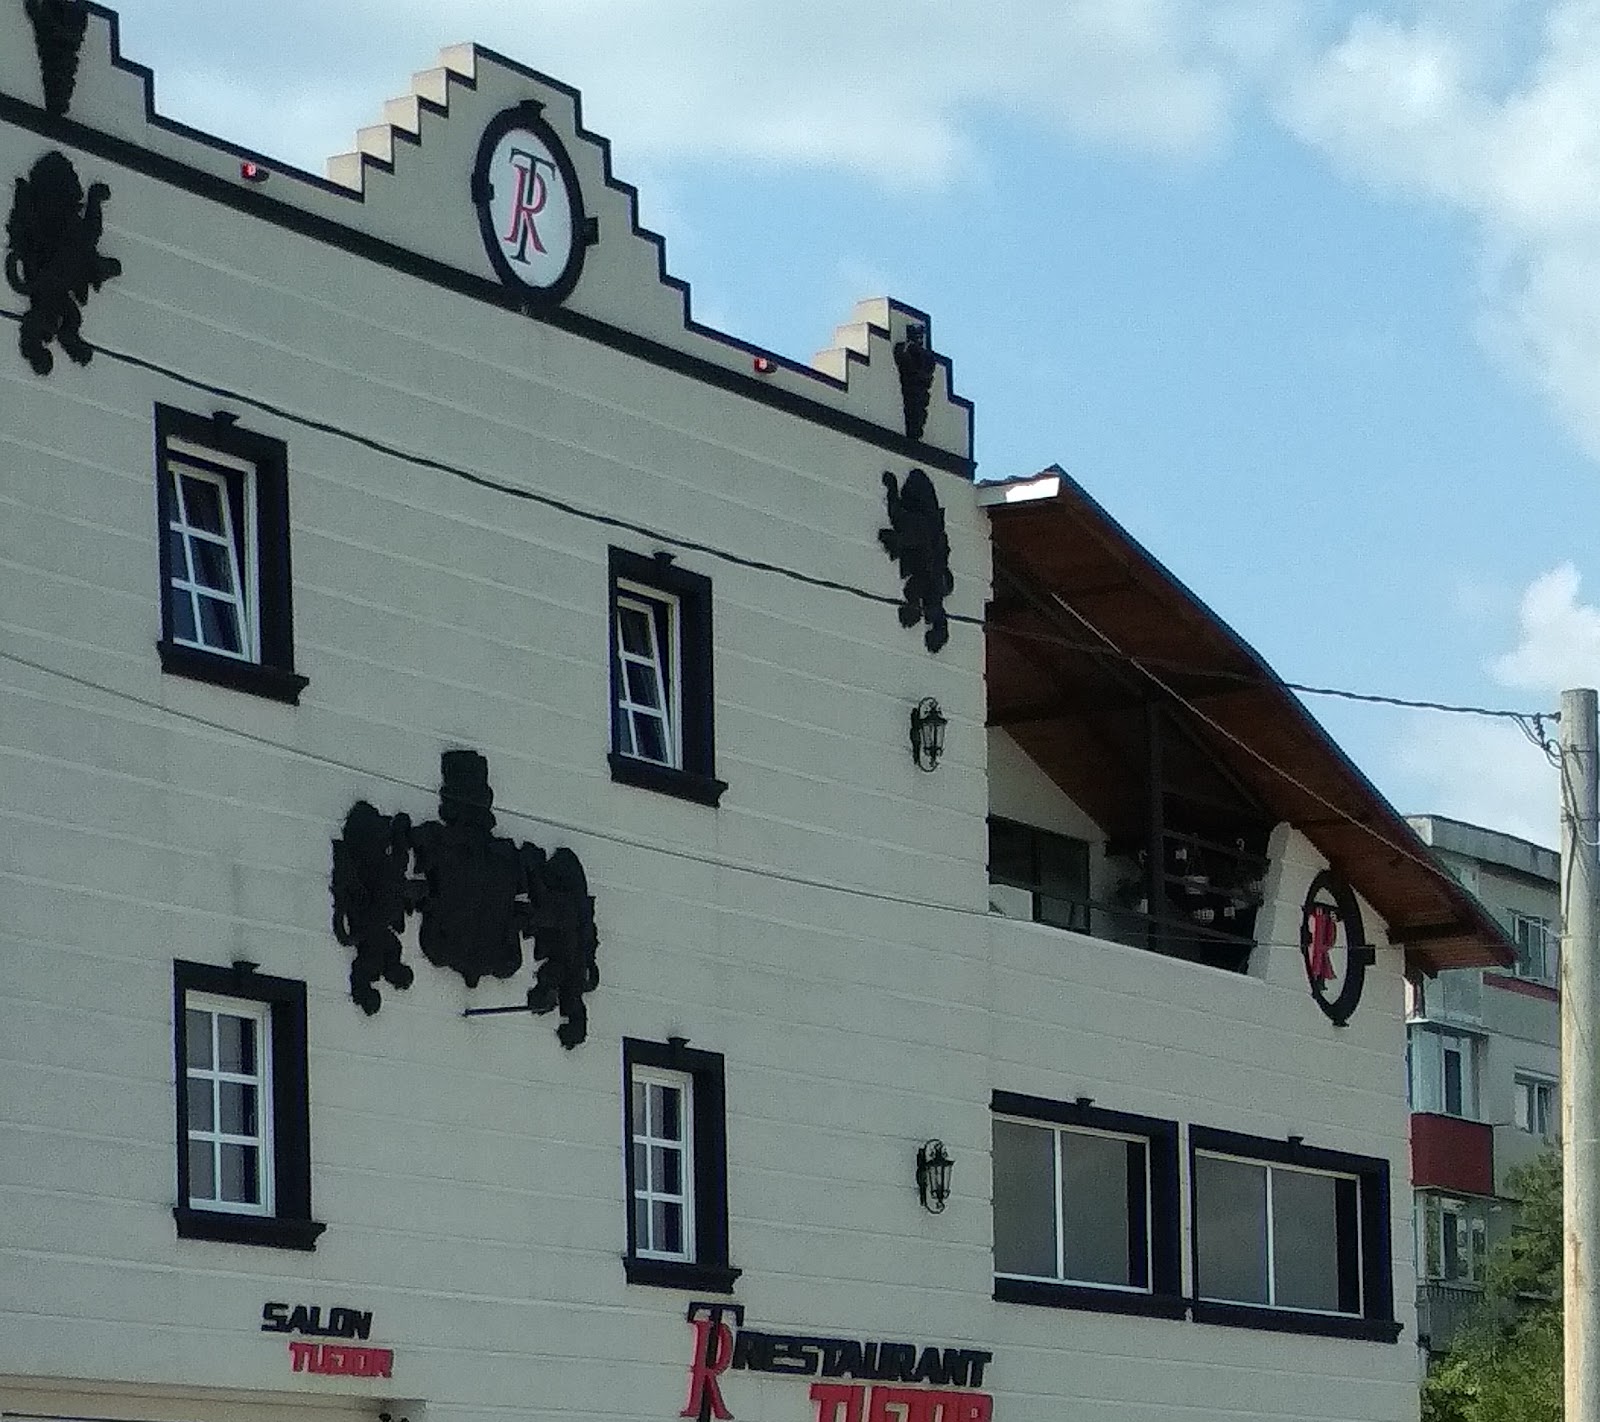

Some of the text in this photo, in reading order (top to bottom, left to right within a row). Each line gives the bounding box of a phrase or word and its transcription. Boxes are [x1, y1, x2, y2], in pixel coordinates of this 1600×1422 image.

[261, 1302, 373, 1340] SALON
[288, 1341, 394, 1378] TUDOR
[731, 1330, 994, 1388] RESTAURANT
